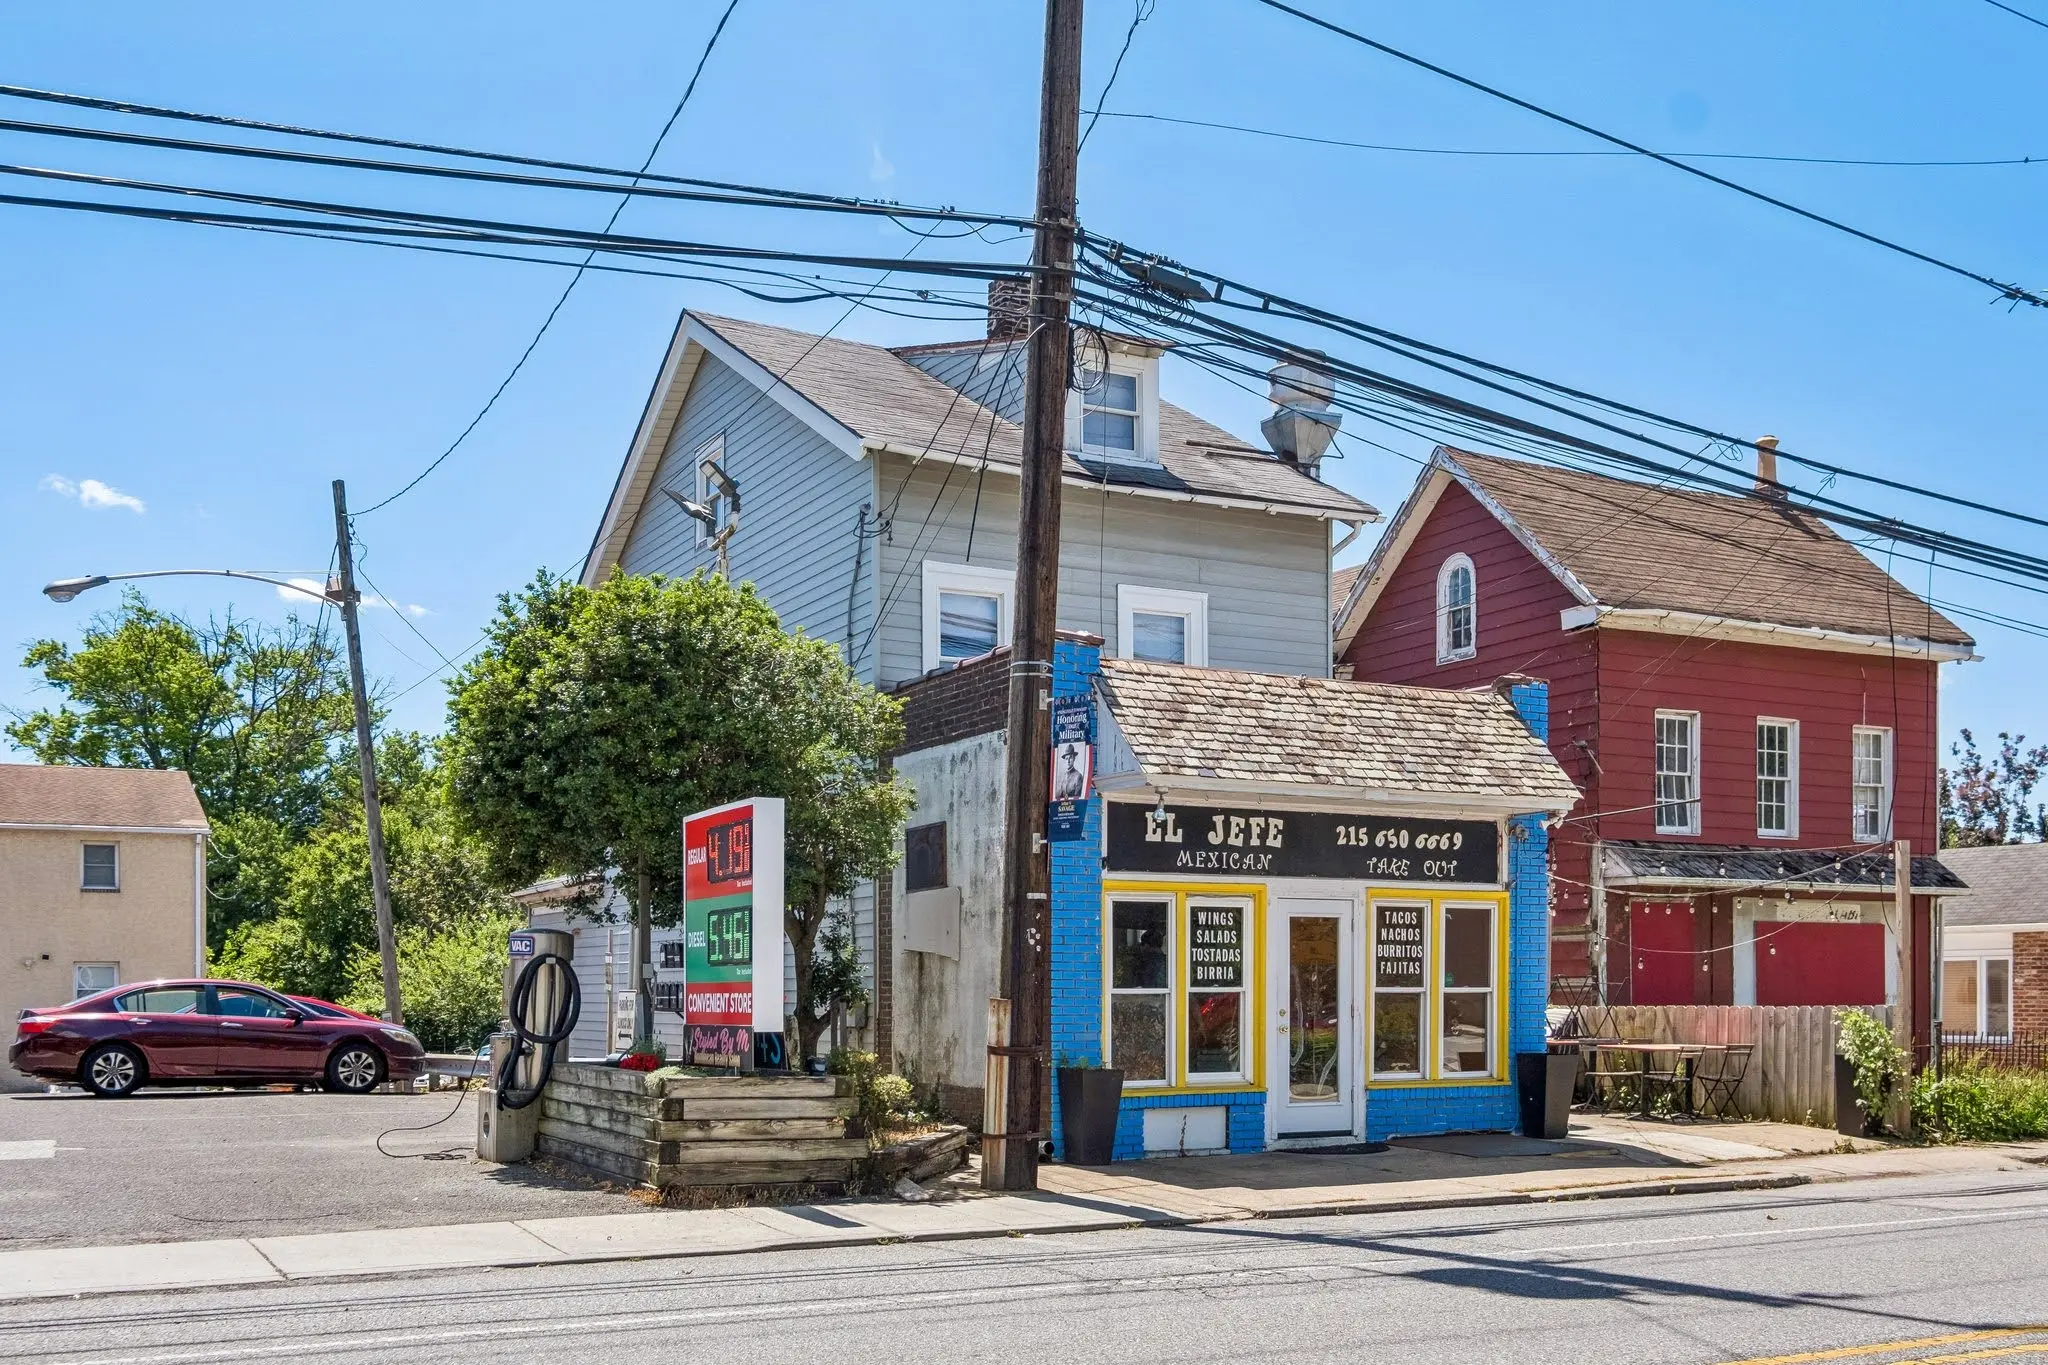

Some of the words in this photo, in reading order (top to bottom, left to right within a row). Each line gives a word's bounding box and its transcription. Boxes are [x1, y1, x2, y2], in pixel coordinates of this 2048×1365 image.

[1057, 712, 1088, 725] Honoring
[1059, 729, 1086, 740] Military
[1145, 811, 1183, 843] EL
[1207, 814, 1284, 848] JEFE
[1336, 825, 1369, 847] 215
[1375, 828, 1409, 849] 650
[1415, 832, 1463, 850] 6669
[687, 846, 707, 866] REGULAR
[1176, 850, 1272, 870] MEXICAN
[1366, 856, 1411, 877] TAKE
[1423, 860, 1458, 877] OUT
[1198, 911, 1234, 926] WINGS
[1384, 911, 1417, 925] TACOS
[688, 930, 706, 948] DIESEL
[1196, 929, 1237, 944] SALADS
[1381, 927, 1421, 941] NACHOS
[511, 940, 531, 952] VAC
[1377, 944, 1423, 958] BURRITOS
[1191, 947, 1241, 962] TOSTADAS
[1197, 966, 1234, 980] BIRRIA
[1380, 961, 1421, 975] FAJITAS
[687, 992, 730, 1013] CONVENIENT
[729, 992, 752, 1014] STORE
[720, 1027, 734, 1057] By
